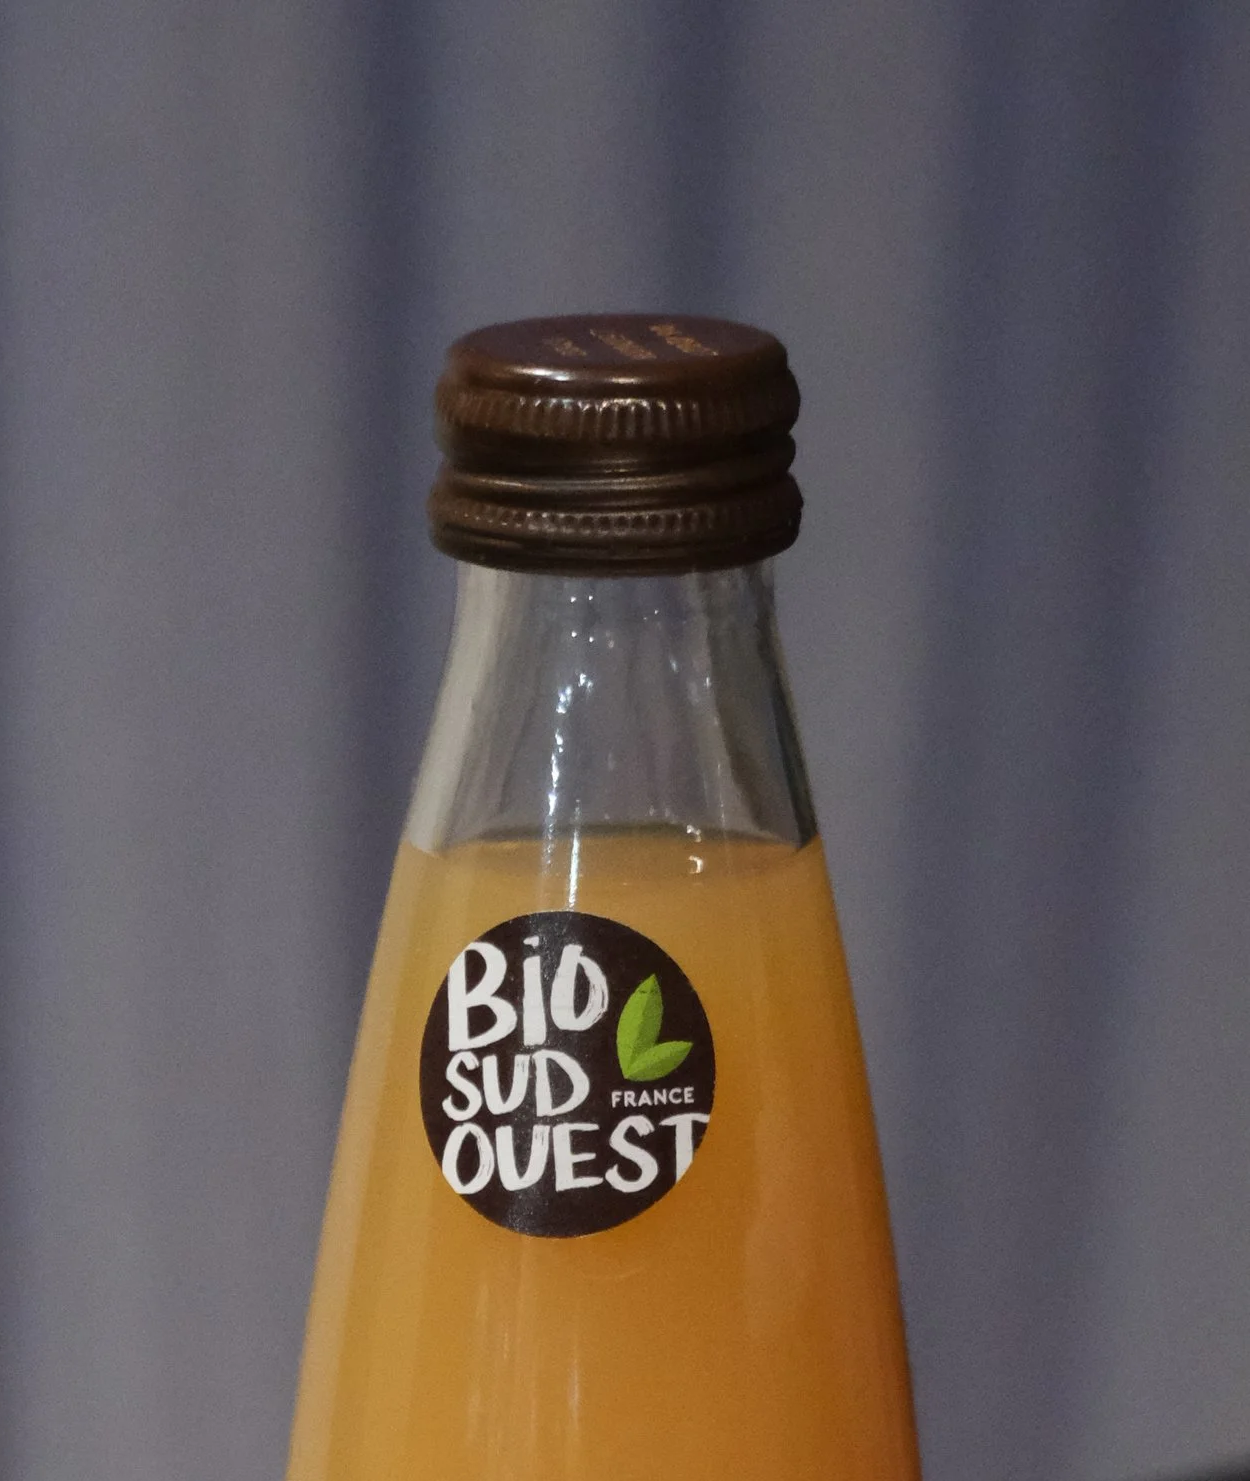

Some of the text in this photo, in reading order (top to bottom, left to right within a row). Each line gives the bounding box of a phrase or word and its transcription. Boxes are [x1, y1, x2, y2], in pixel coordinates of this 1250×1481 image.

[442, 1050, 591, 1122] SUD
[611, 1086, 695, 1109] FRANCE
[442, 1113, 711, 1194] OUEST
